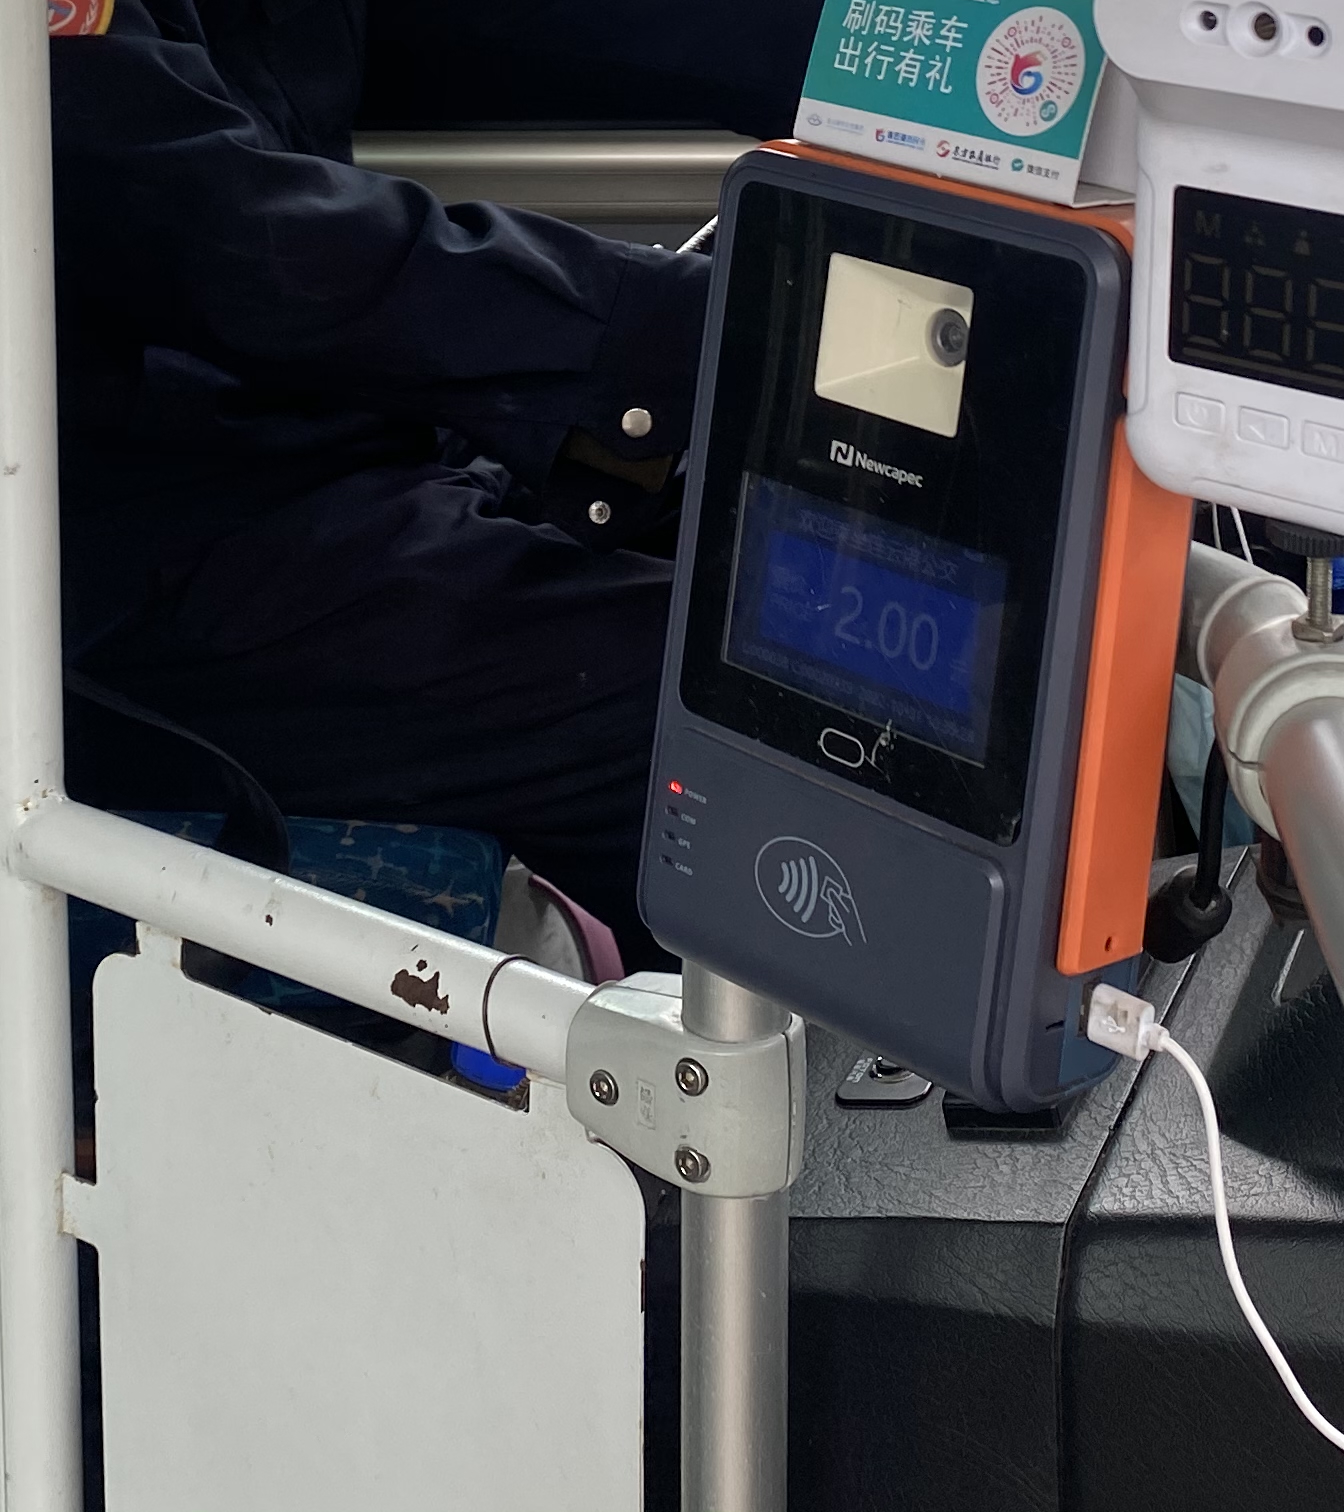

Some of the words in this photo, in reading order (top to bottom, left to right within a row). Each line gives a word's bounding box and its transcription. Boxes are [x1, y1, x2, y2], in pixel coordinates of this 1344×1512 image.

[833, 36, 953, 94] 出行有礼
[855, 450, 924, 488] Newcapec
[834, 585, 939, 671] 2.00
[684, 788, 707, 804] POWER
[680, 813, 697, 825] COM
[674, 862, 694, 876] CARD
